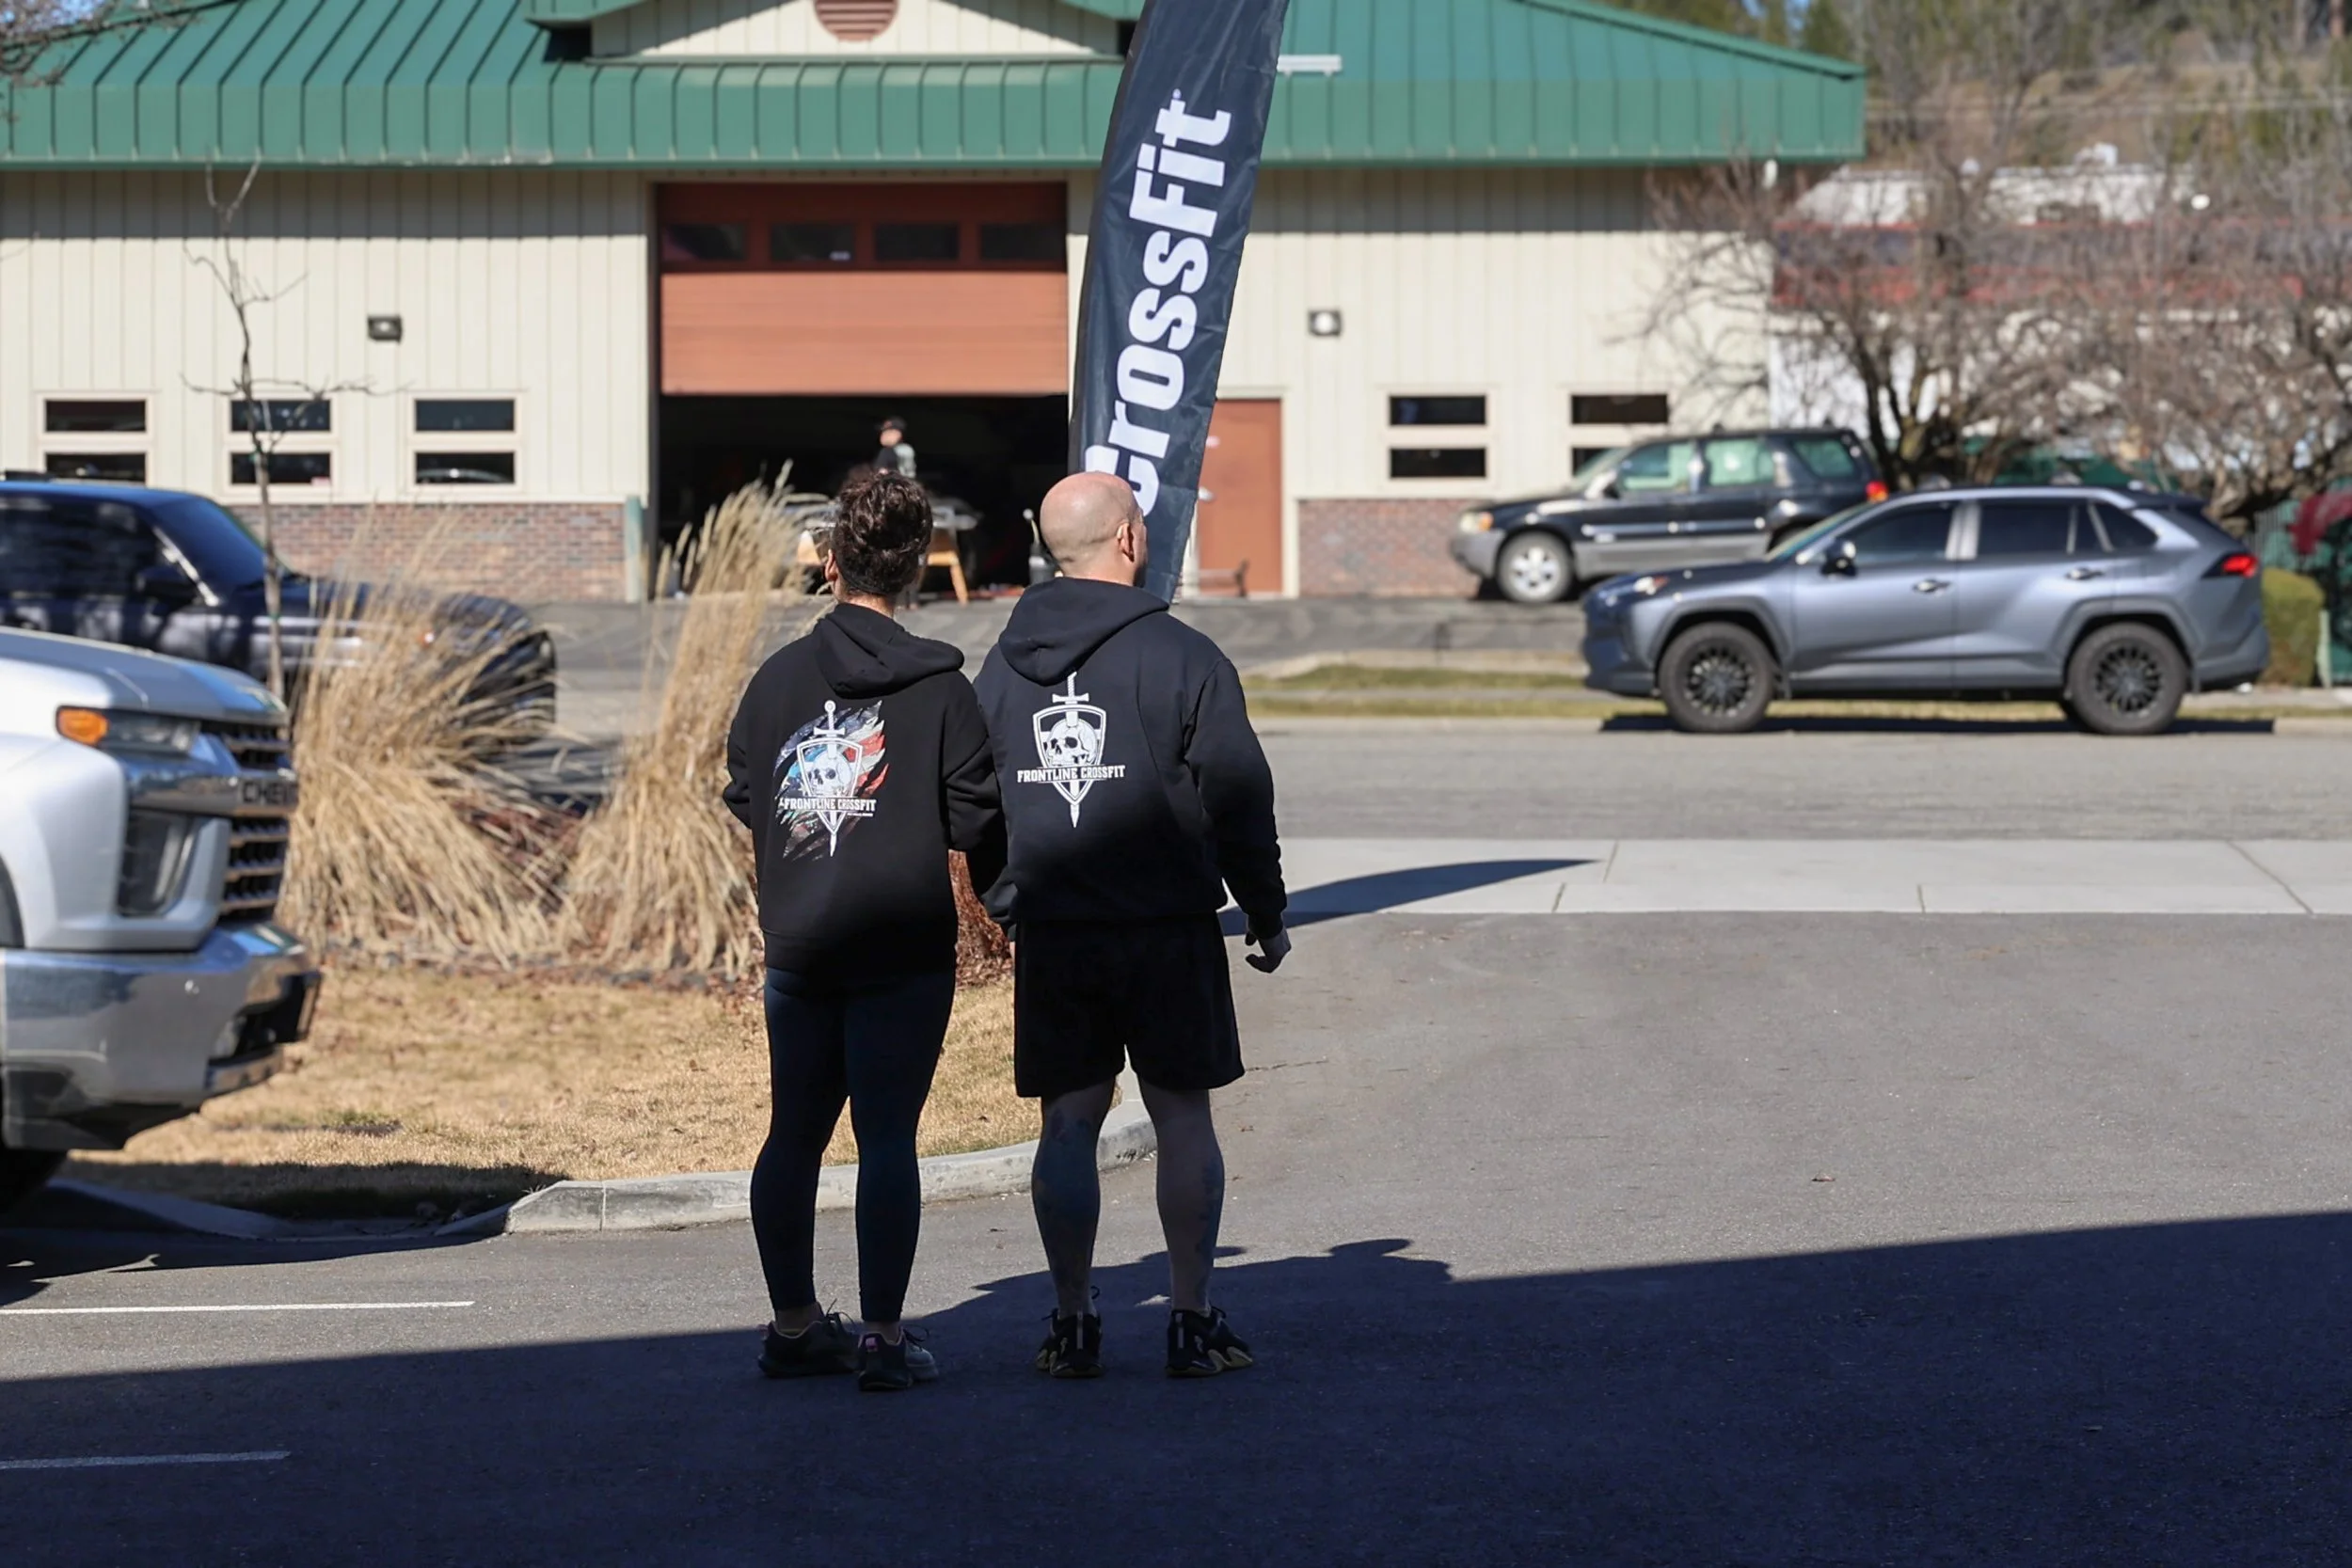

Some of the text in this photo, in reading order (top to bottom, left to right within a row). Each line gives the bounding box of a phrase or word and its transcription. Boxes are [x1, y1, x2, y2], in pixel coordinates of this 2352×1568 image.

[1017, 765, 1126, 784] FRONTLINE CROSSFIT
[784, 798, 877, 812] FRONTLINE CROSSFIT
